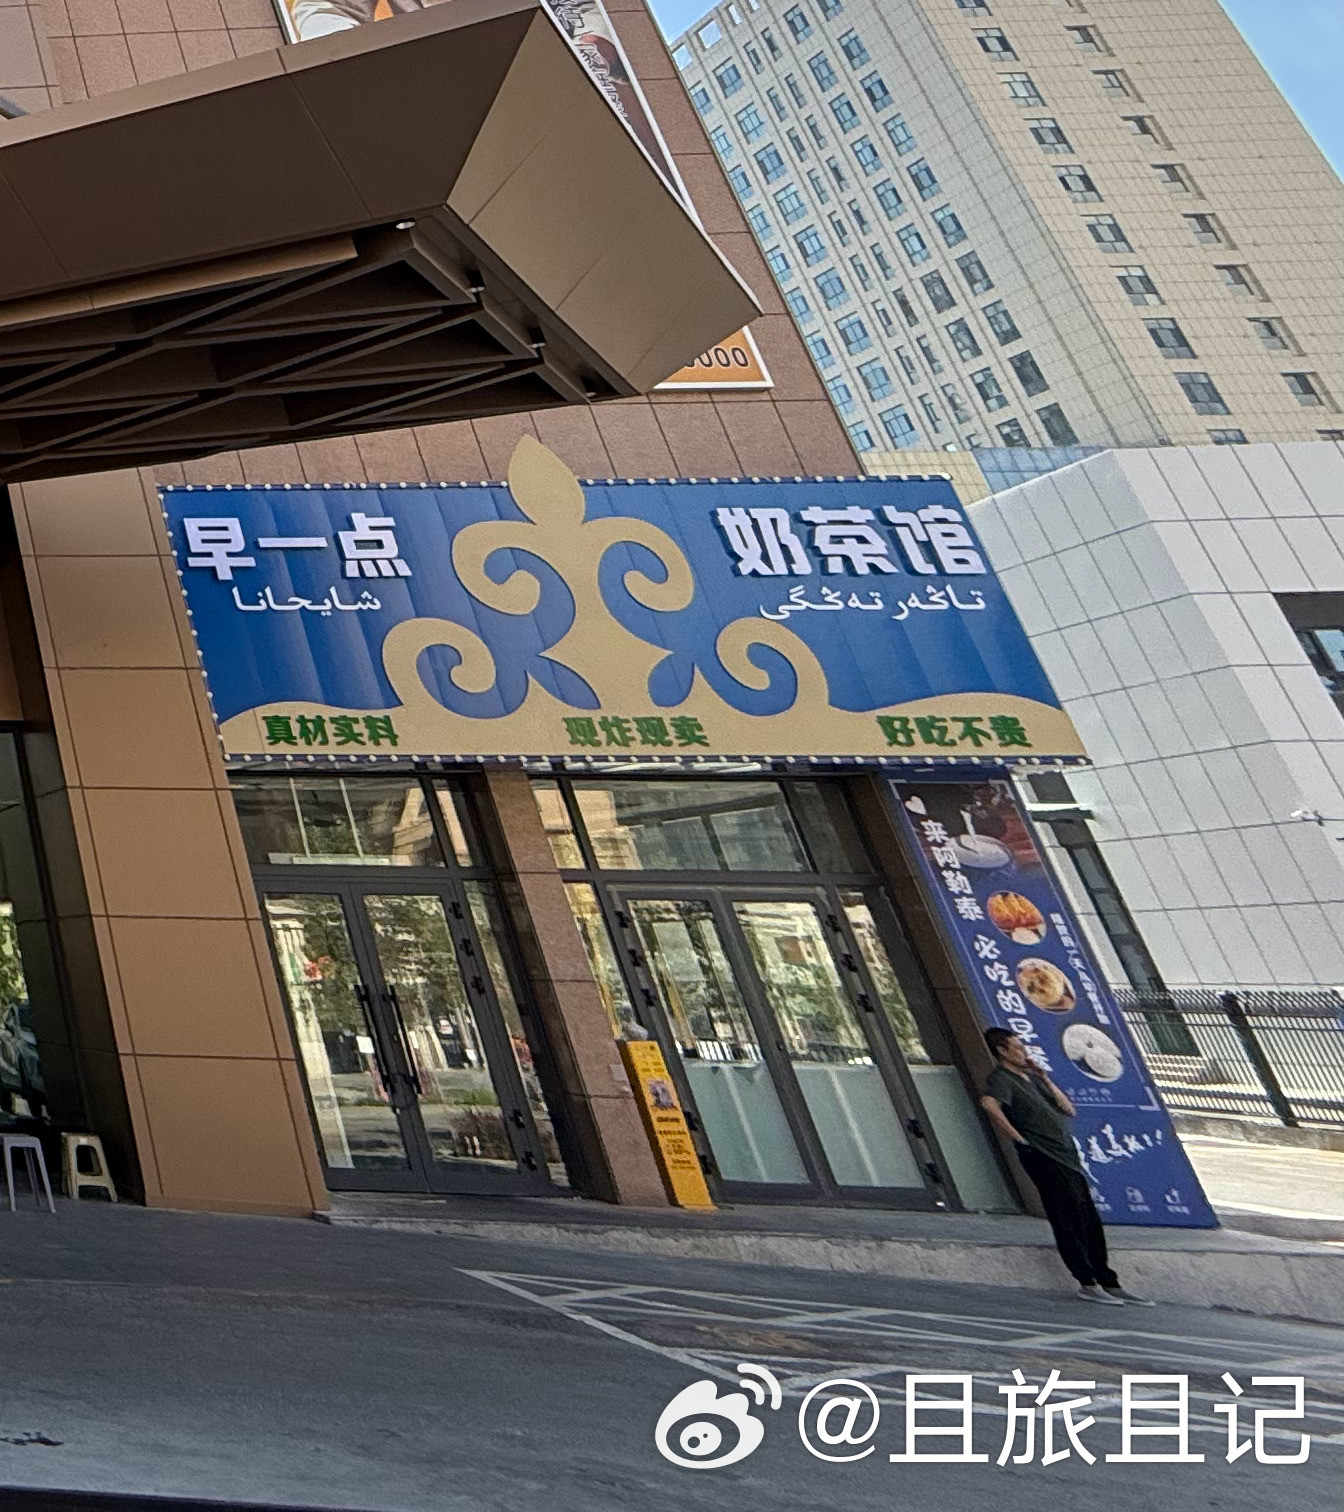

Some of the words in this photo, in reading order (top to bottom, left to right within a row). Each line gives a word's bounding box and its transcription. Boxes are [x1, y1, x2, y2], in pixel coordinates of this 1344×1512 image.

[685, 346, 749, 368] 000
[183, 512, 412, 580] 早一点
[715, 505, 988, 575] 奶茶馆
[261, 714, 399, 747] 真材实料
[563, 715, 710, 748] 现炸现卖
[876, 715, 1033, 748] 好吃不贵
